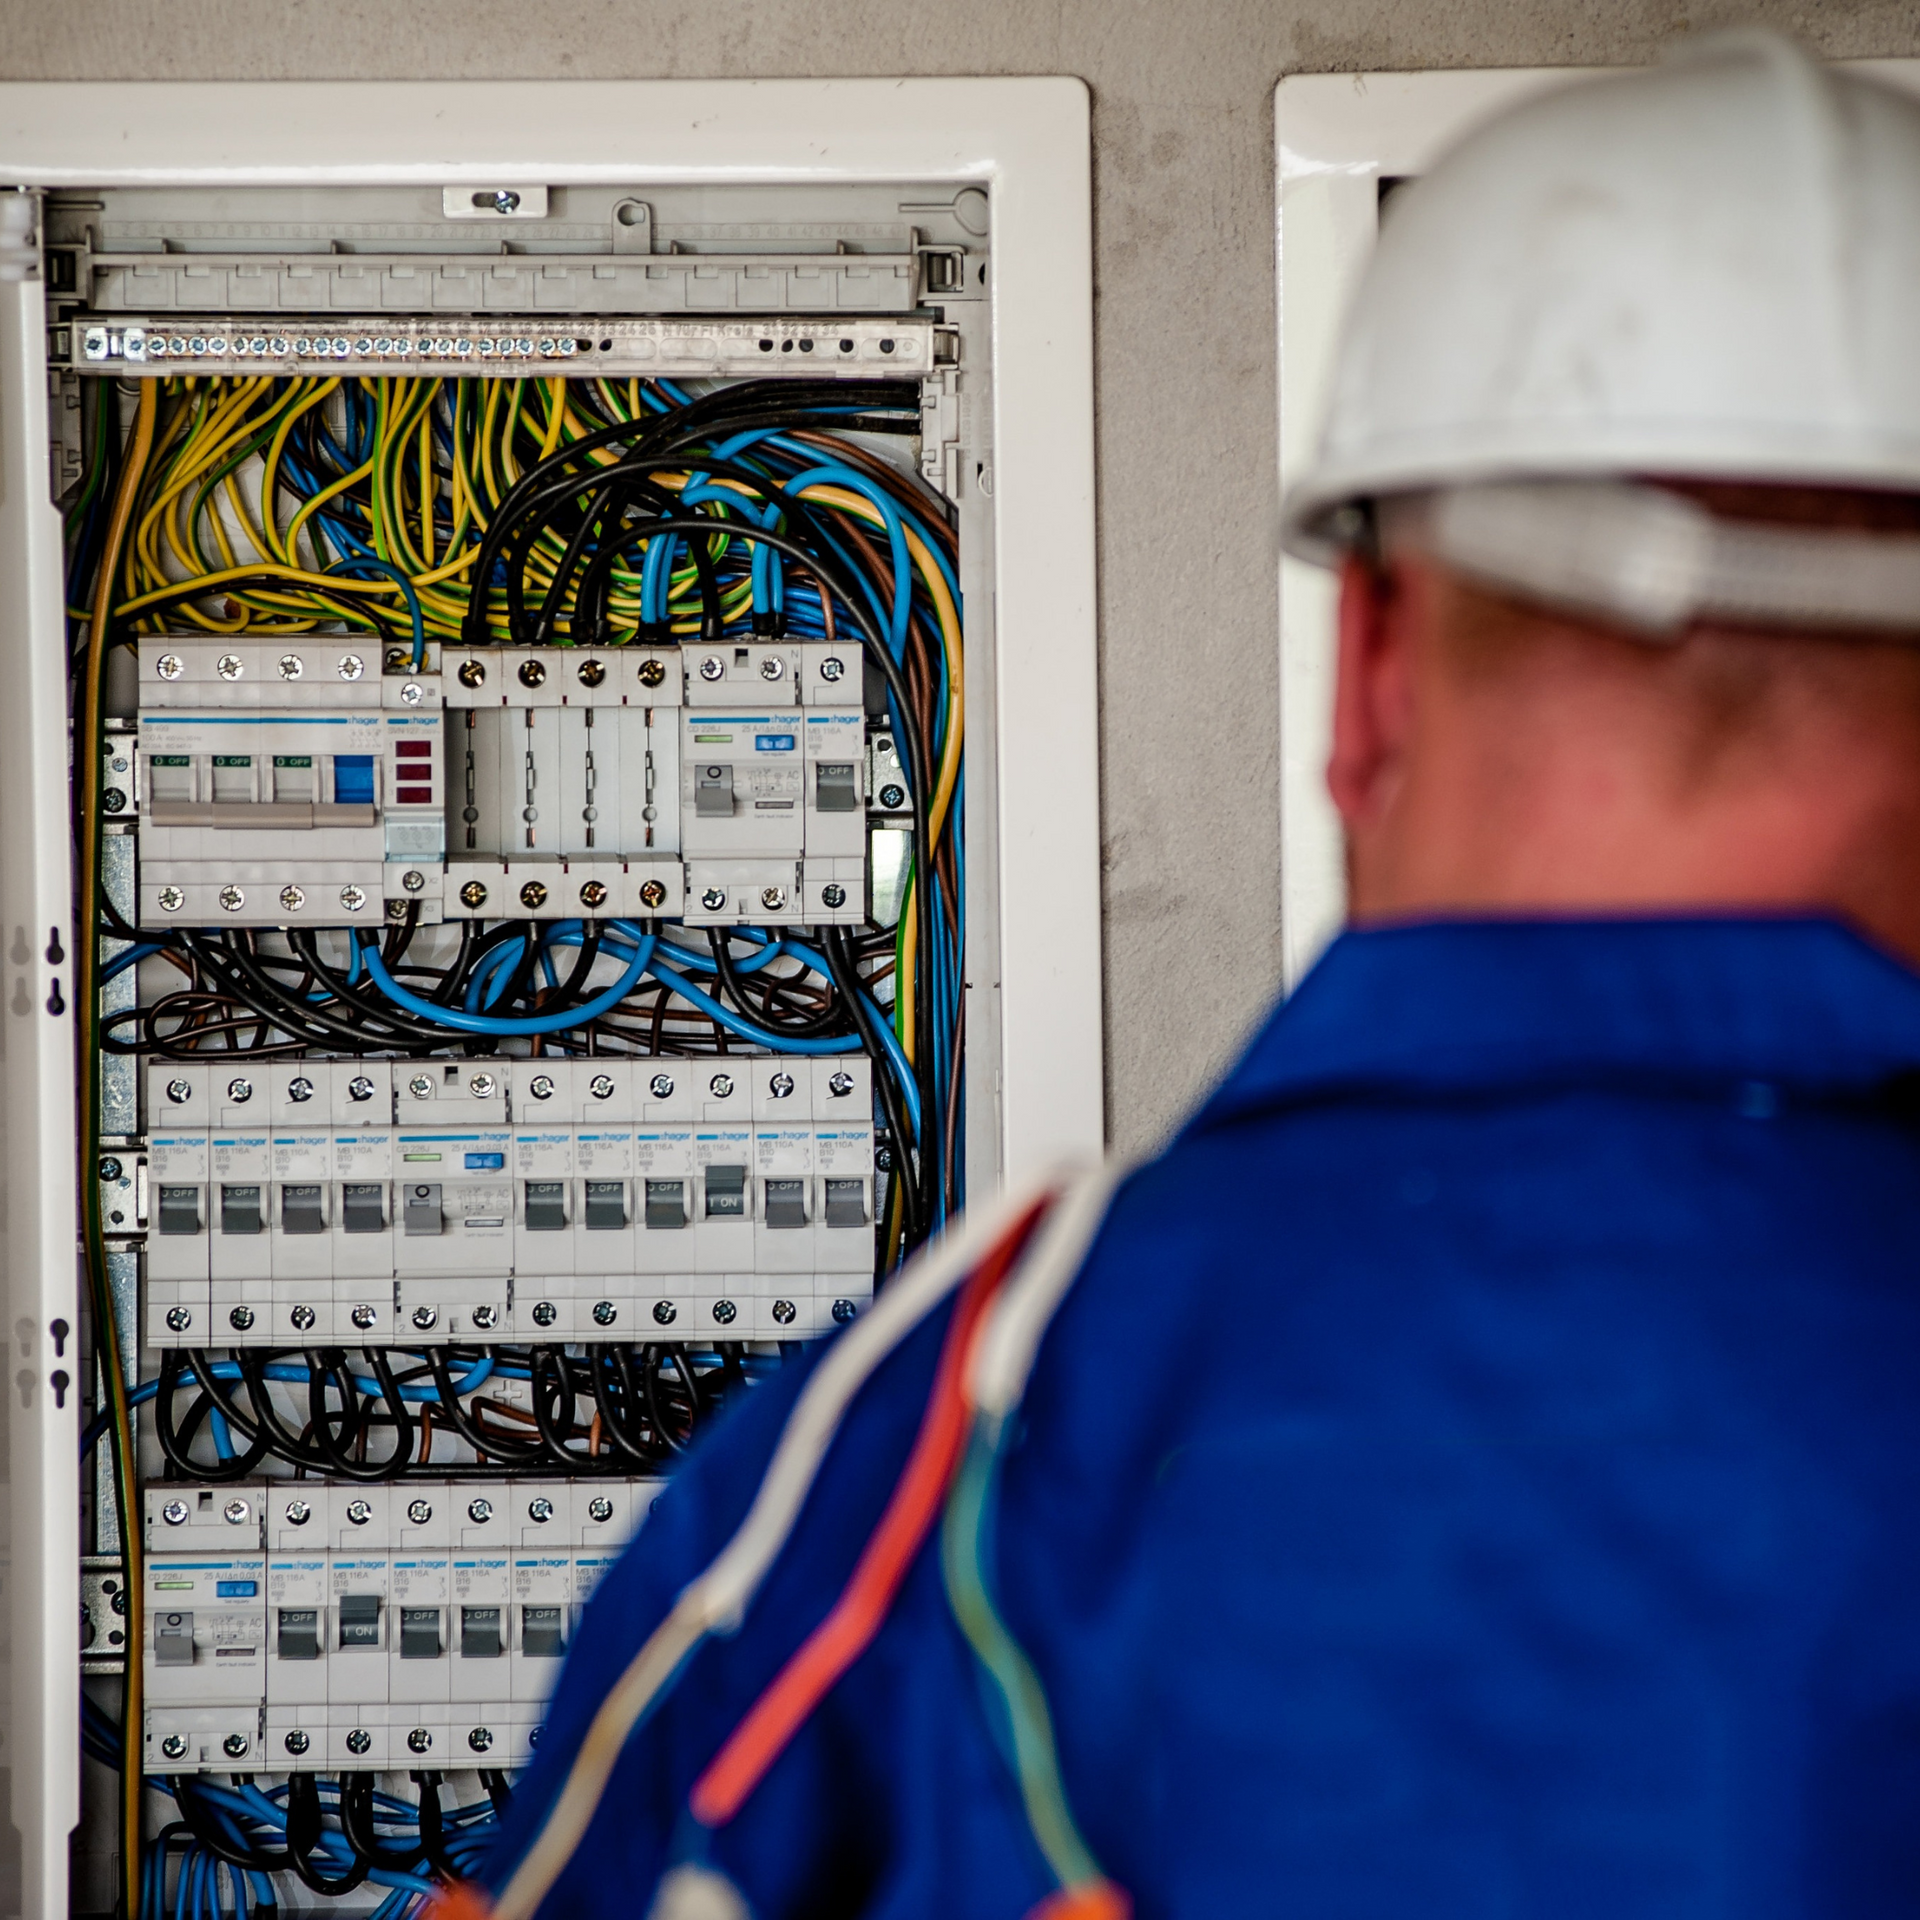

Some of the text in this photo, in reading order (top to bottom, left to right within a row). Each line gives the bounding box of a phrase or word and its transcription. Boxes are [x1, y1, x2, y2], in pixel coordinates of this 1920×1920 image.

[168, 757, 188, 765] OFF
[230, 757, 250, 765] OFF
[290, 758, 311, 766] OFF
[828, 767, 849, 775] OFF
[501, 1068, 508, 1076] N
[538, 1185, 559, 1193] OFF
[599, 1184, 620, 1192] OFF
[659, 1184, 680, 1192] OFF
[779, 1182, 800, 1190] OFF
[173, 1189, 194, 1197] OFF
[235, 1189, 256, 1197] OFF
[297, 1188, 318, 1196] OFF
[721, 1198, 738, 1207] ON
[292, 1614, 313, 1622] OFF
[413, 1612, 435, 1620] OFF
[475, 1611, 495, 1619] OFF
[250, 1618, 262, 1628] AC
[356, 1627, 372, 1636] ON
